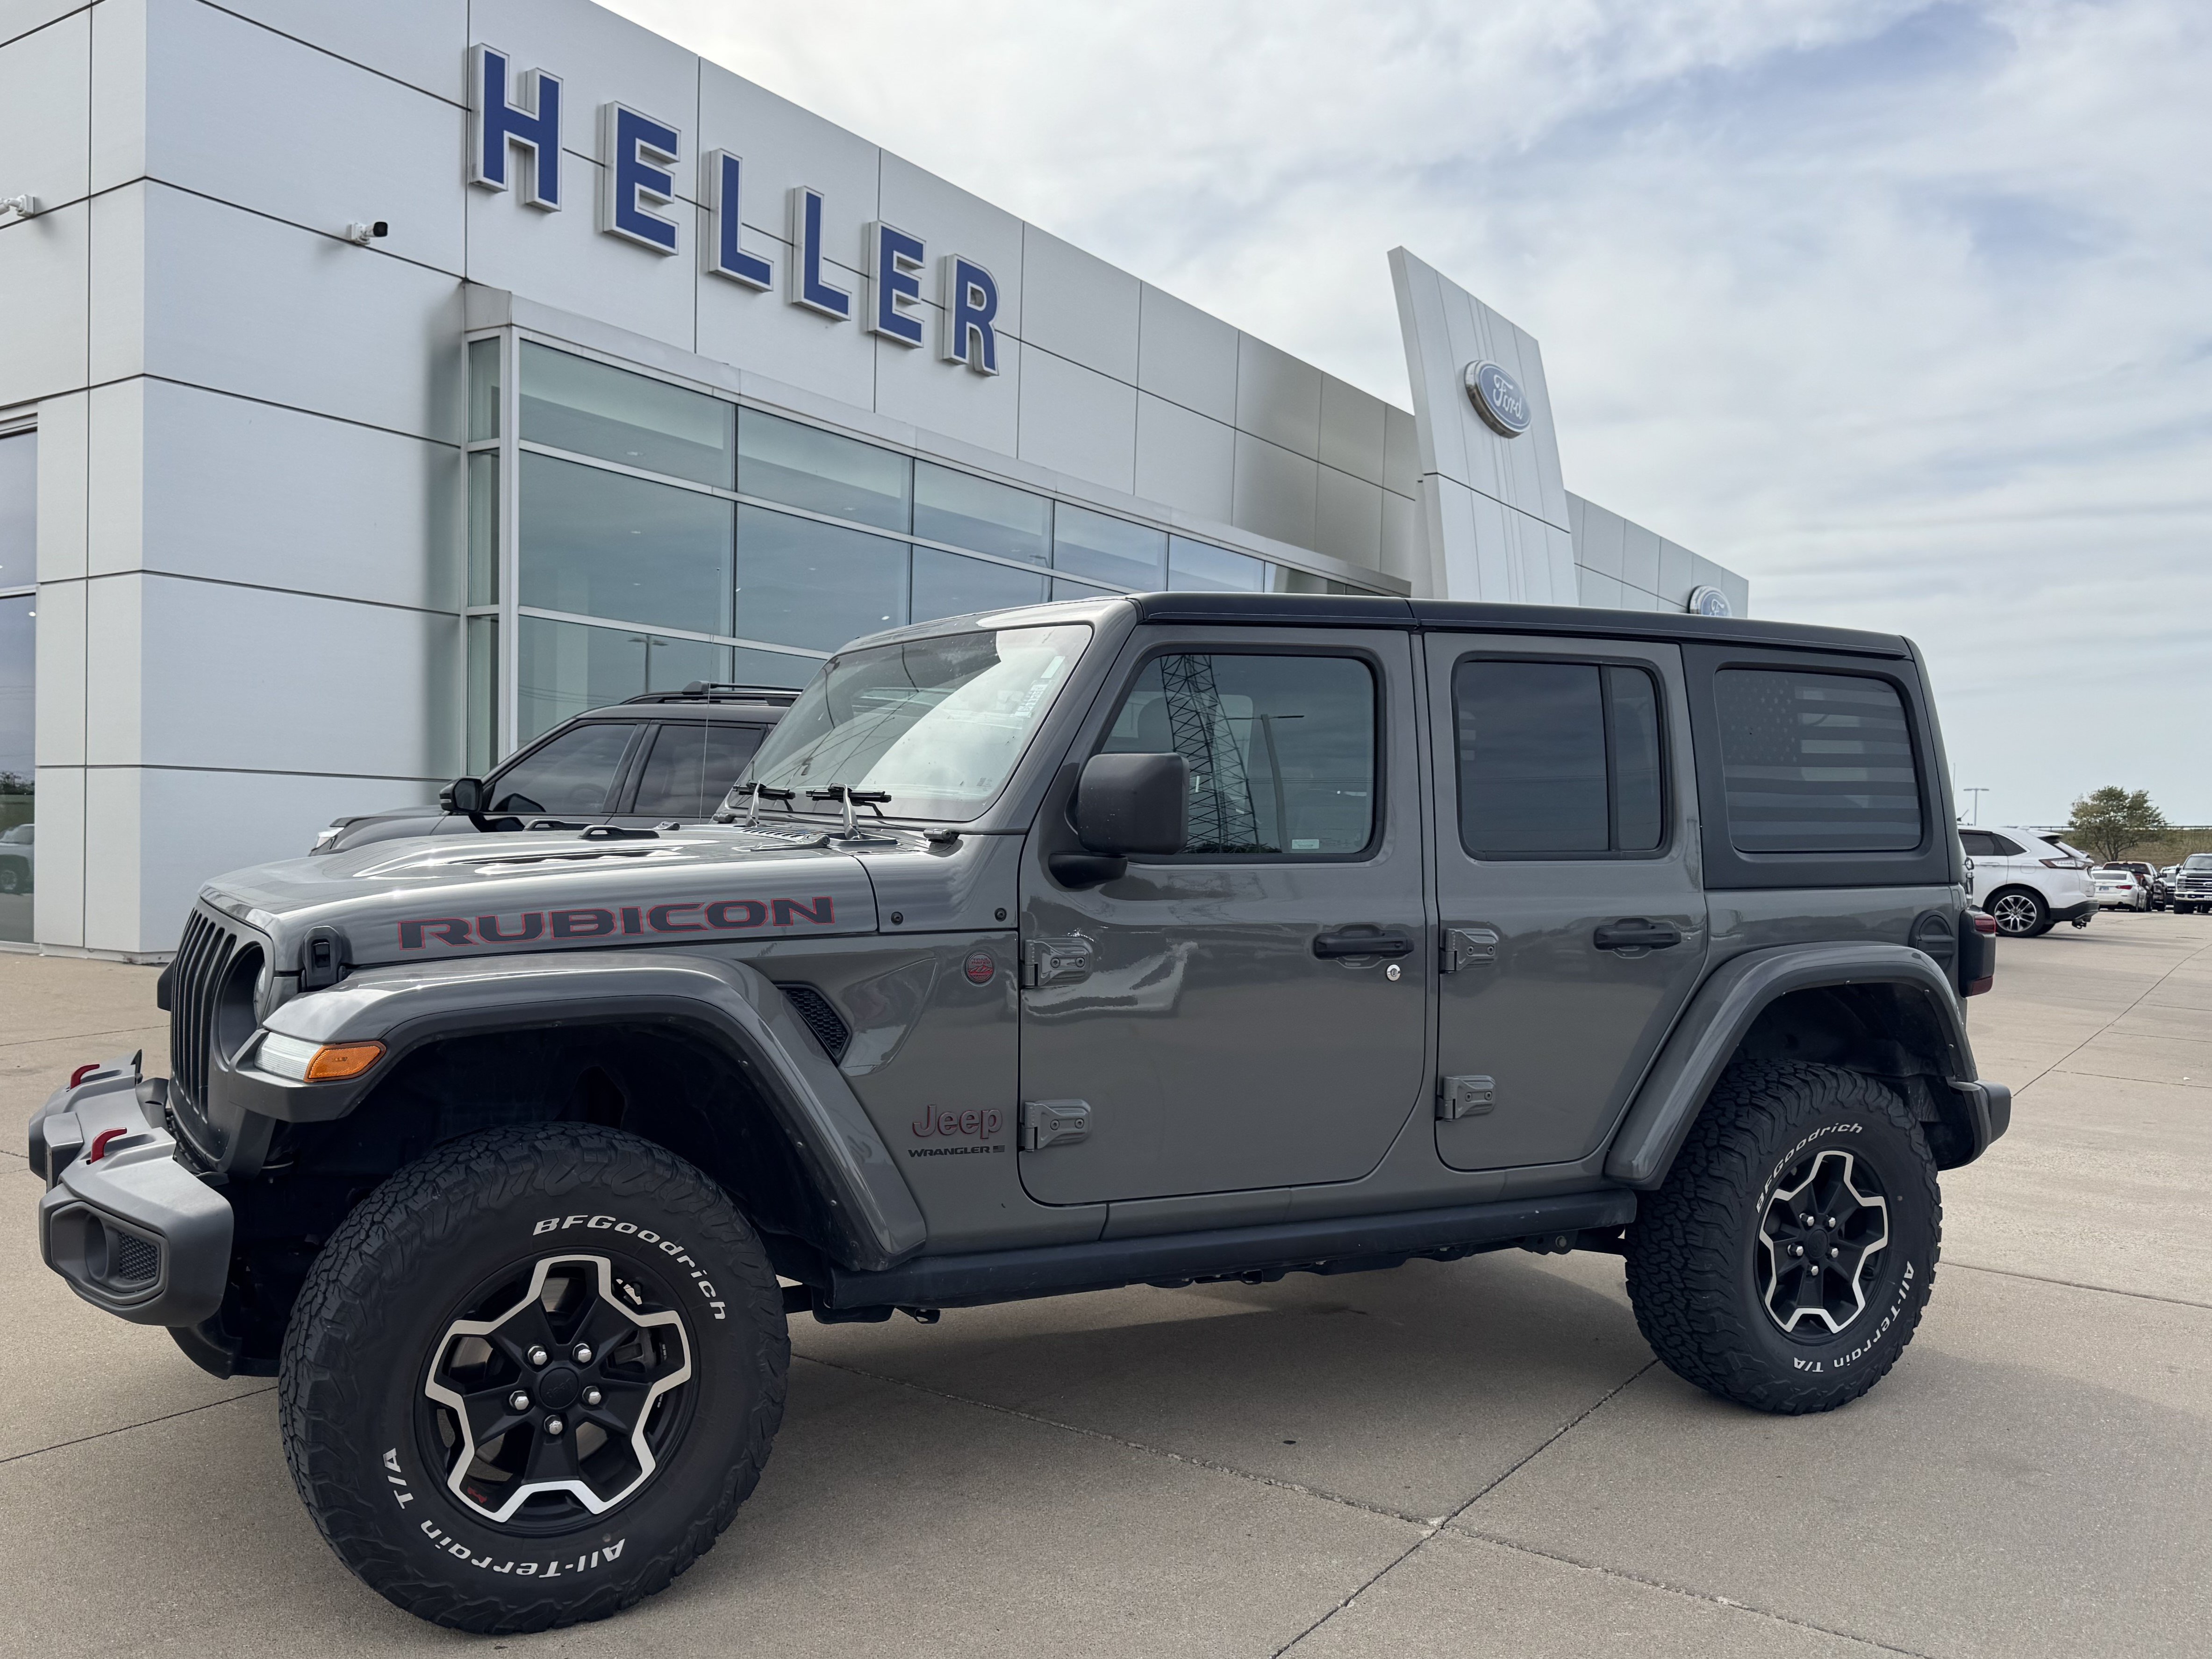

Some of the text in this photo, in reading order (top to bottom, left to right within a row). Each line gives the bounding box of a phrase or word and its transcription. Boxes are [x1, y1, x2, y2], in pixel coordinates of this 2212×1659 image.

[470, 42, 999, 377] HELLER
[1493, 374, 1523, 419] Ford
[398, 896, 835, 951] RUBICON
[908, 1145, 990, 1158] WRANGLER
[912, 1104, 1003, 1139] Jeep
[1755, 1123, 1863, 1214] BFGoodrich
[532, 1215, 726, 1320] BFGoodrich
[1793, 1260, 1914, 1373] All-Terrain T/A
[382, 1446, 626, 1579] All-Terrain T/A
